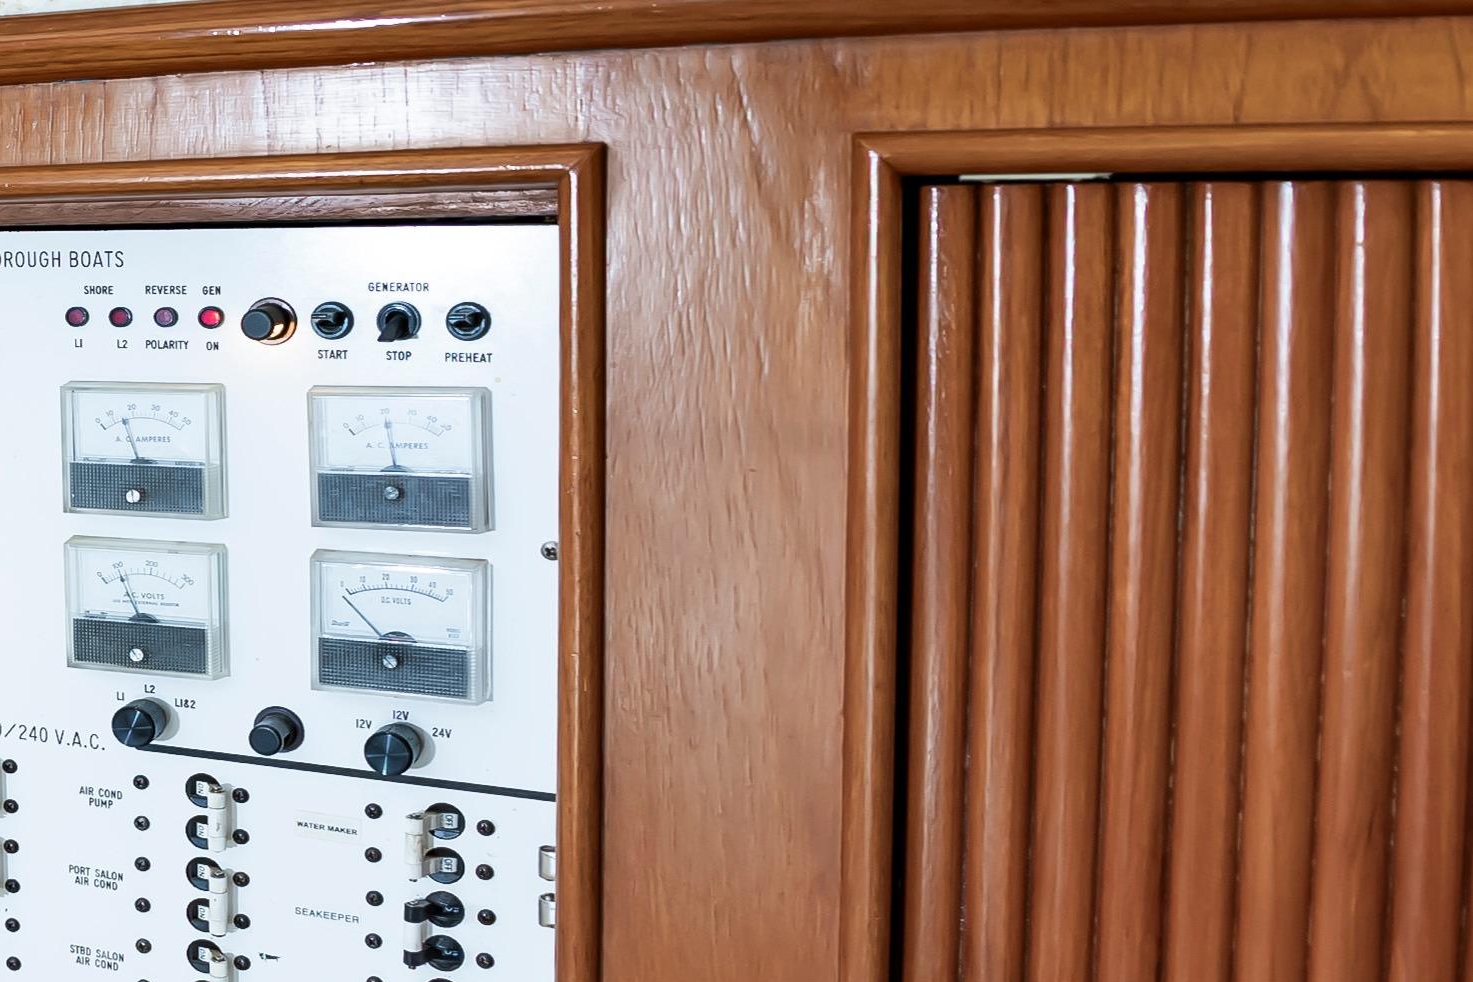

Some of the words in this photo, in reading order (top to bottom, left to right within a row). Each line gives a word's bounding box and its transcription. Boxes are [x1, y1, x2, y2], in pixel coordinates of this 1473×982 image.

[69, 251, 125, 268] BOATS
[84, 286, 114, 294] SHORE
[145, 286, 187, 294] REVERSE
[202, 286, 221, 295] GEN
[368, 283, 429, 292] GENERATOR
[117, 340, 127, 348] L2
[145, 340, 188, 349] POLARITY
[206, 342, 219, 350] ON
[318, 350, 348, 359] START
[386, 351, 412, 360] STOP
[445, 353, 492, 363] PREHEAT
[145, 685, 155, 694] L2
[393, 710, 409, 720] 12V
[356, 719, 371, 728] 12V
[432, 728, 451, 738] 24V
[55, 729, 106, 751] V.A.C.
[79, 786, 93, 796] AIR
[99, 789, 122, 800] COND
[89, 798, 113, 809] PUMP
[297, 821, 325, 830] WATER
[327, 825, 357, 835] MAKER
[69, 865, 90, 876] PORT
[95, 869, 123, 881] SALON
[75, 876, 89, 885] AIR
[94, 879, 118, 890] COND
[295, 907, 359, 923] SEAKEEPER
[70, 945, 91, 955] STBD
[96, 949, 124, 962] SALON
[76, 956, 90, 966] AIR
[95, 960, 118, 971] COND
